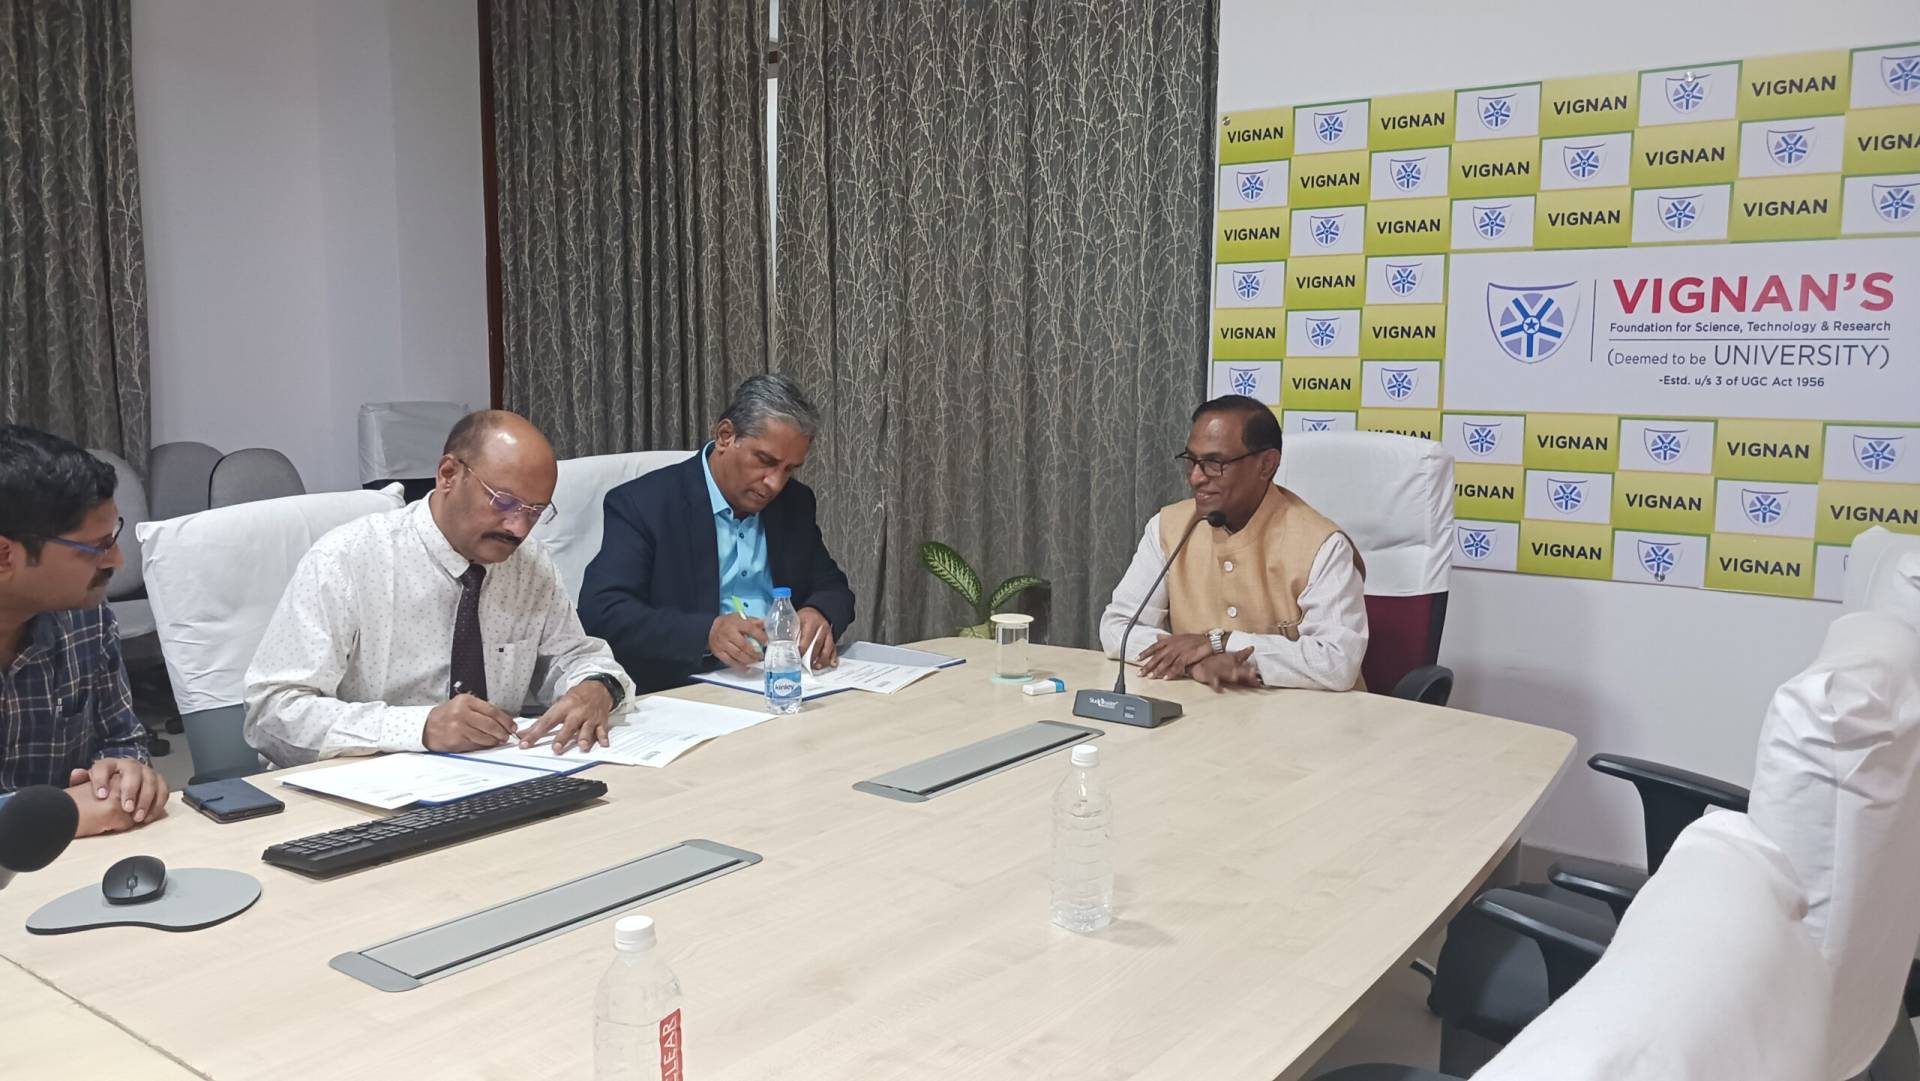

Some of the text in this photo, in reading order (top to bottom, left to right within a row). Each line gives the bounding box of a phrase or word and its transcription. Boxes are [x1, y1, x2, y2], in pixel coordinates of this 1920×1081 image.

[1751, 75, 1837, 98] VIGNAN
[1553, 94, 1627, 116] VIGNAN
[1380, 110, 1445, 131] VIGNAN
[1227, 125, 1284, 144] VIGNAN
[1645, 146, 1725, 167] VIGNAN
[1461, 159, 1530, 179] VIGNAN
[1300, 171, 1360, 189] VIGNAN
[1547, 208, 1621, 227] VIGNAN
[1743, 198, 1828, 218] VIGNAN
[1223, 225, 1280, 242] VIGNAN
[1376, 217, 1441, 235] VIGNAN
[1295, 273, 1356, 289] VIGNAN
[1612, 271, 1894, 315] VIGNAN'S
[1220, 326, 1276, 340] VIGNAN
[1372, 324, 1436, 339] VIGNAN
[1609, 319, 1892, 334] Foundation for Science, Technology & Research
[1607, 344, 1890, 370] (Deemed to be UNIVERSITY)
[1292, 376, 1352, 390] VIGNAN
[1658, 375, 1825, 388] -Estd. u/s 3 of UGC Act 1956
[1537, 434, 1608, 451] VIGNAN
[1726, 441, 1810, 460] VIGNAN
[1625, 492, 1702, 512] VIGNAN
[1830, 503, 1919, 526] VIGNAN
[1531, 541, 1602, 561] VIGNAN
[1719, 555, 1801, 578] VIGNAN
[662, 1015, 679, 1081] LEAR
